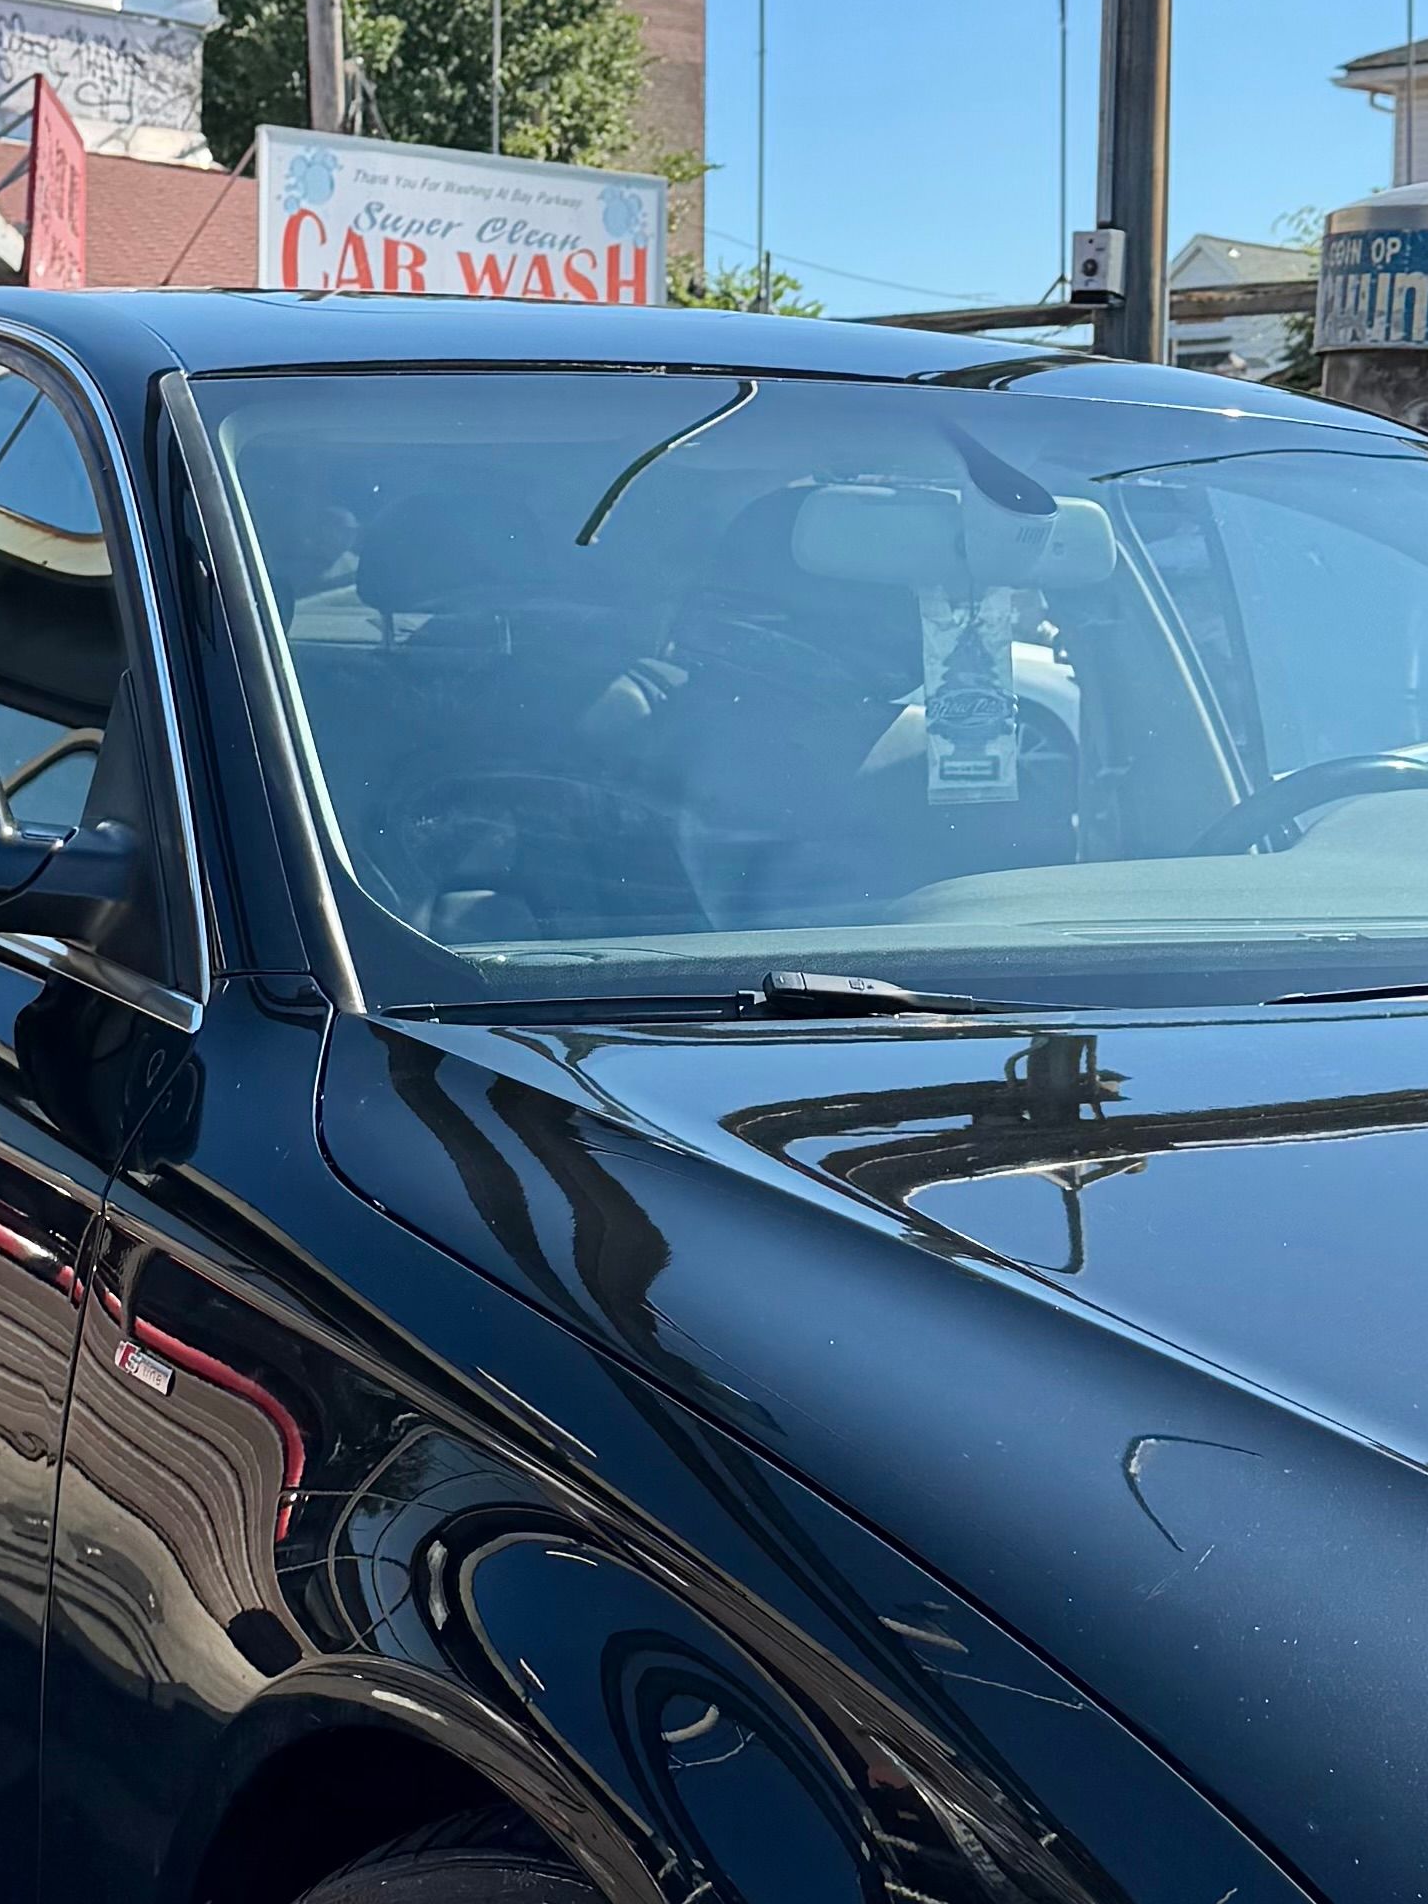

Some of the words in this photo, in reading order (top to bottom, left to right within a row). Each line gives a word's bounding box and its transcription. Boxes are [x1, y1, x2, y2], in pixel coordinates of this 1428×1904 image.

[353, 169, 390, 186] Thank
[395, 175, 417, 190] You
[421, 177, 442, 192] For
[444, 181, 494, 200] Washing
[513, 190, 533, 206] Bay
[354, 201, 464, 238] Super
[476, 216, 583, 251] Clean
[282, 208, 428, 293] CAR
[457, 243, 648, 305] WASH
[1372, 237, 1402, 265] OP
